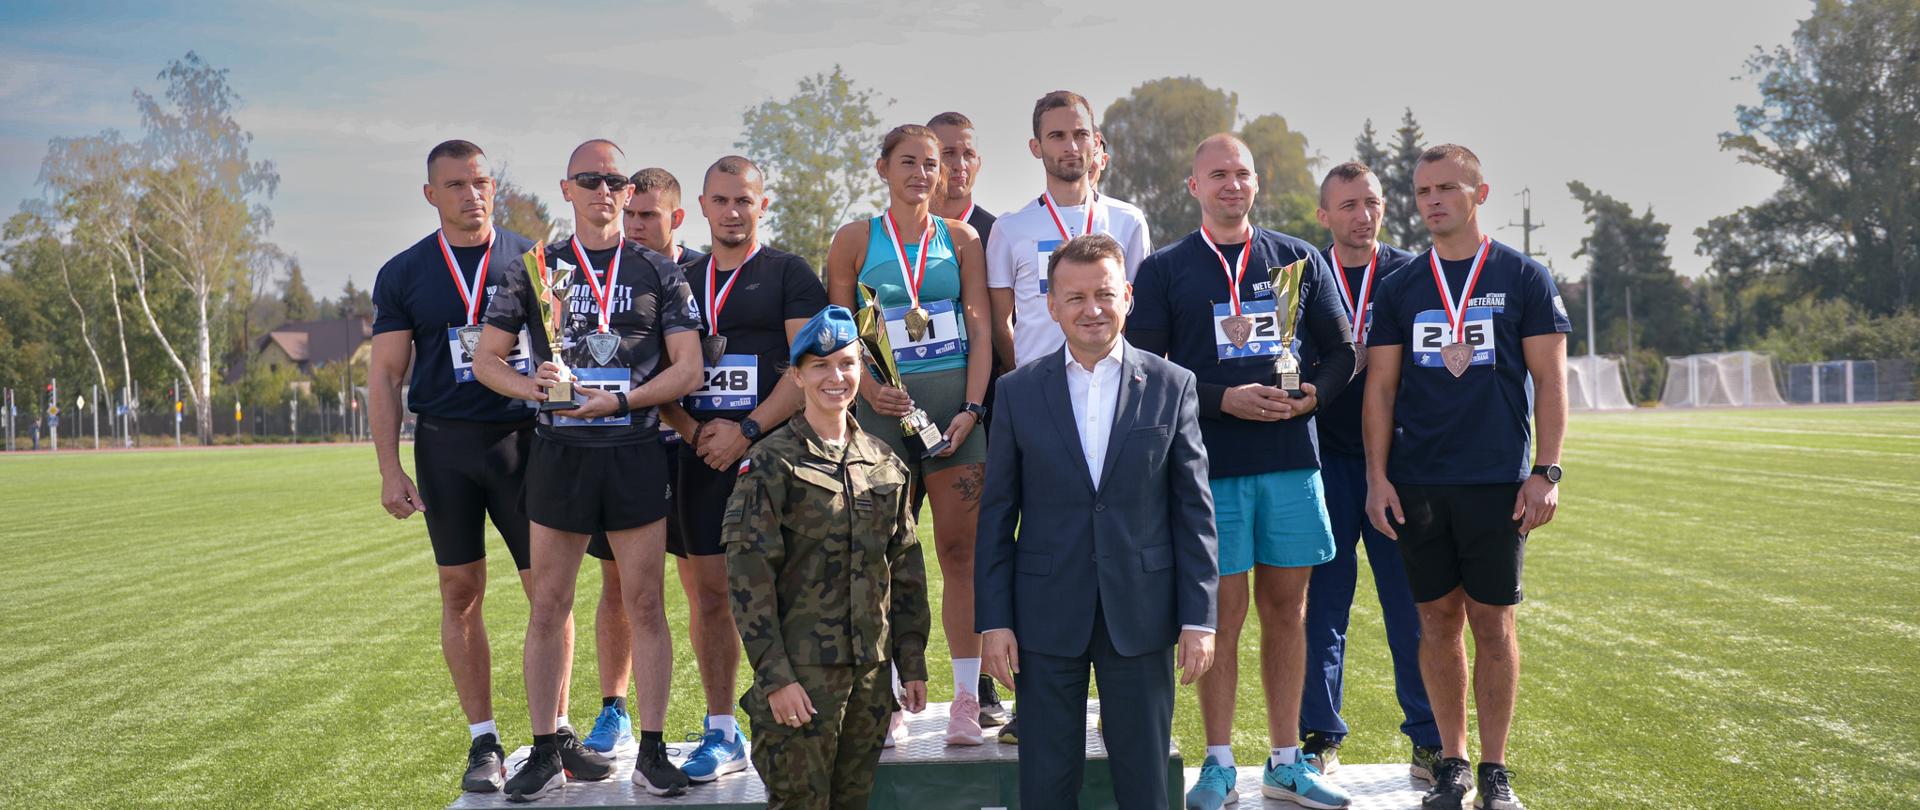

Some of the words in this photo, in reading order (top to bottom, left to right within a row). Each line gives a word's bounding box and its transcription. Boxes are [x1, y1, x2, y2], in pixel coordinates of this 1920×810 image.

[1253, 281, 1272, 292] WETE
[1467, 297, 1505, 307] WETERANA
[696, 370, 749, 391] 248
